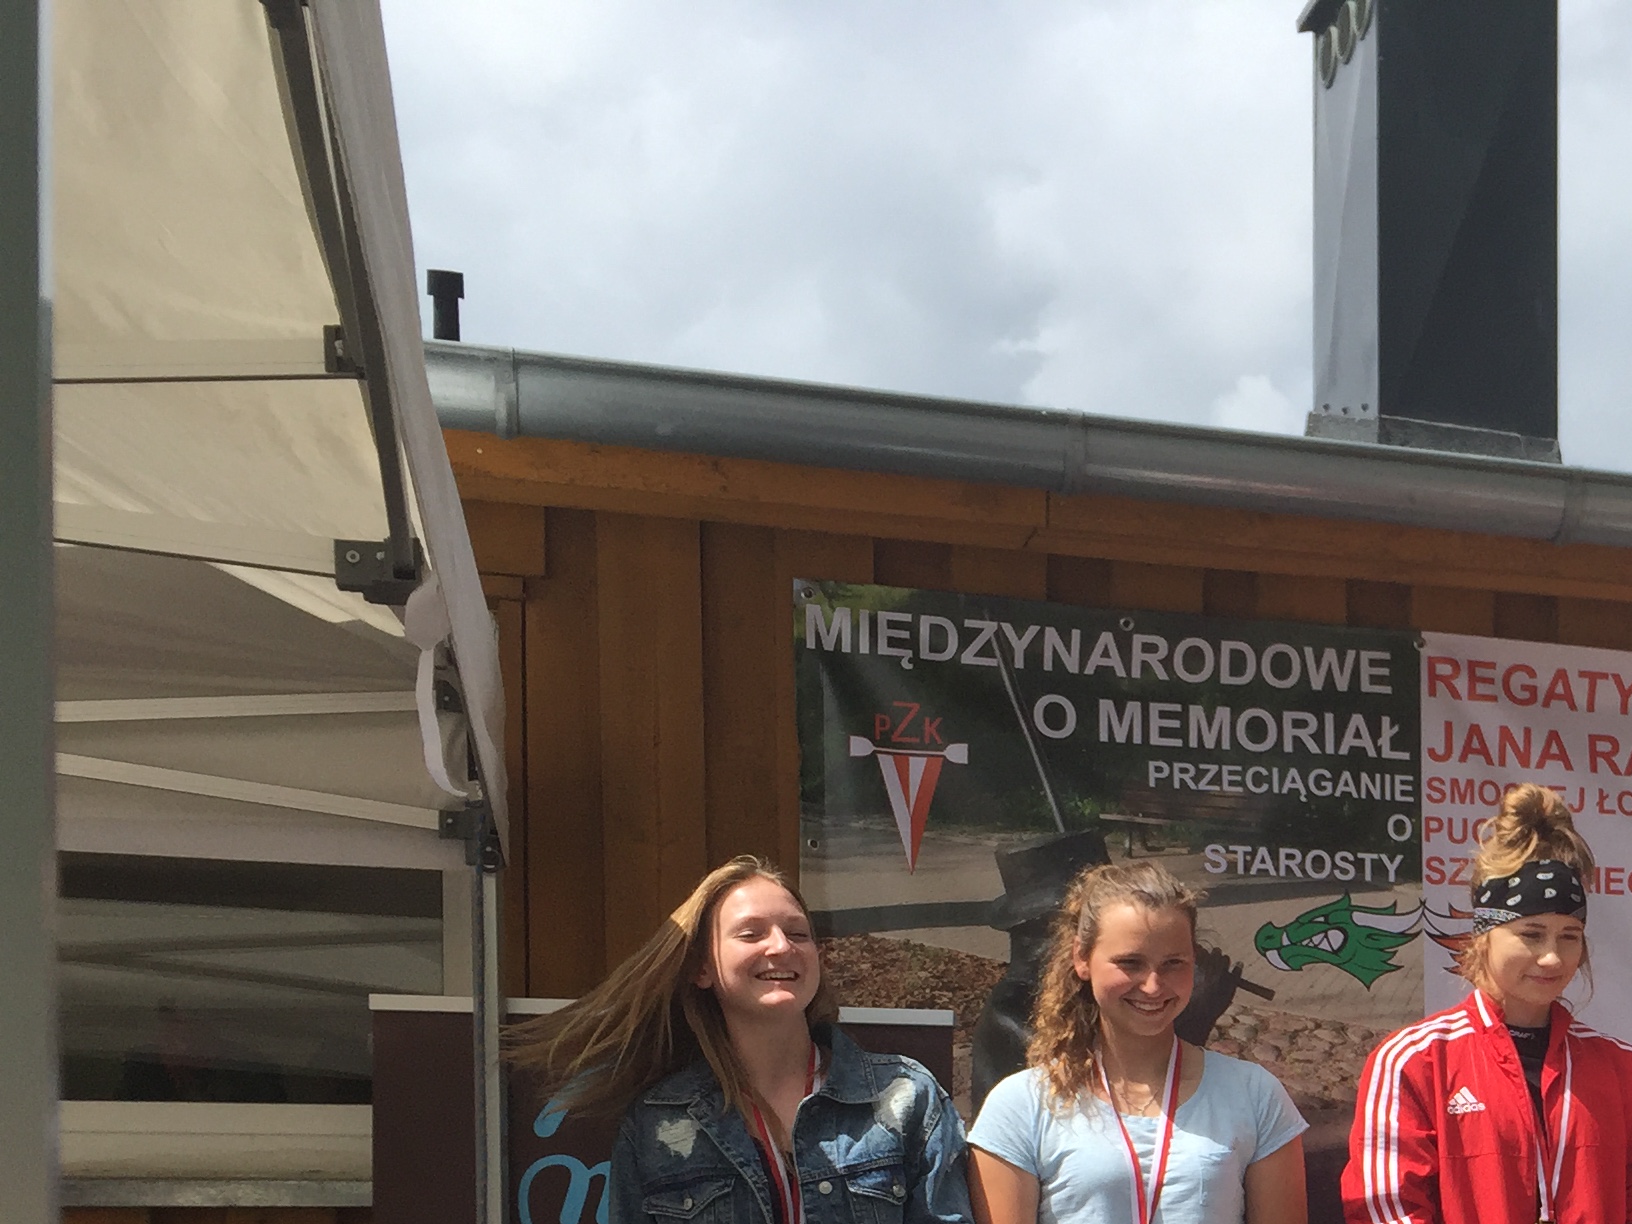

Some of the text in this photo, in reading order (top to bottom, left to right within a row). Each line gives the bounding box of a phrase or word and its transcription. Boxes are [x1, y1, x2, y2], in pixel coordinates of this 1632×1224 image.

[804, 603, 1393, 694] MIĘDZYNARODOWE
[873, 700, 944, 744] PZK
[1034, 694, 1412, 761] O MEMORIAŁ
[1427, 720, 1574, 772] JANA
[1148, 760, 1415, 802] PRZECIĄGANIE
[1425, 777, 1585, 813] SMOJ
[1386, 813, 1413, 842] O
[1203, 844, 1404, 884] STAROSTY
[1447, 1102, 1486, 1115] adidas
